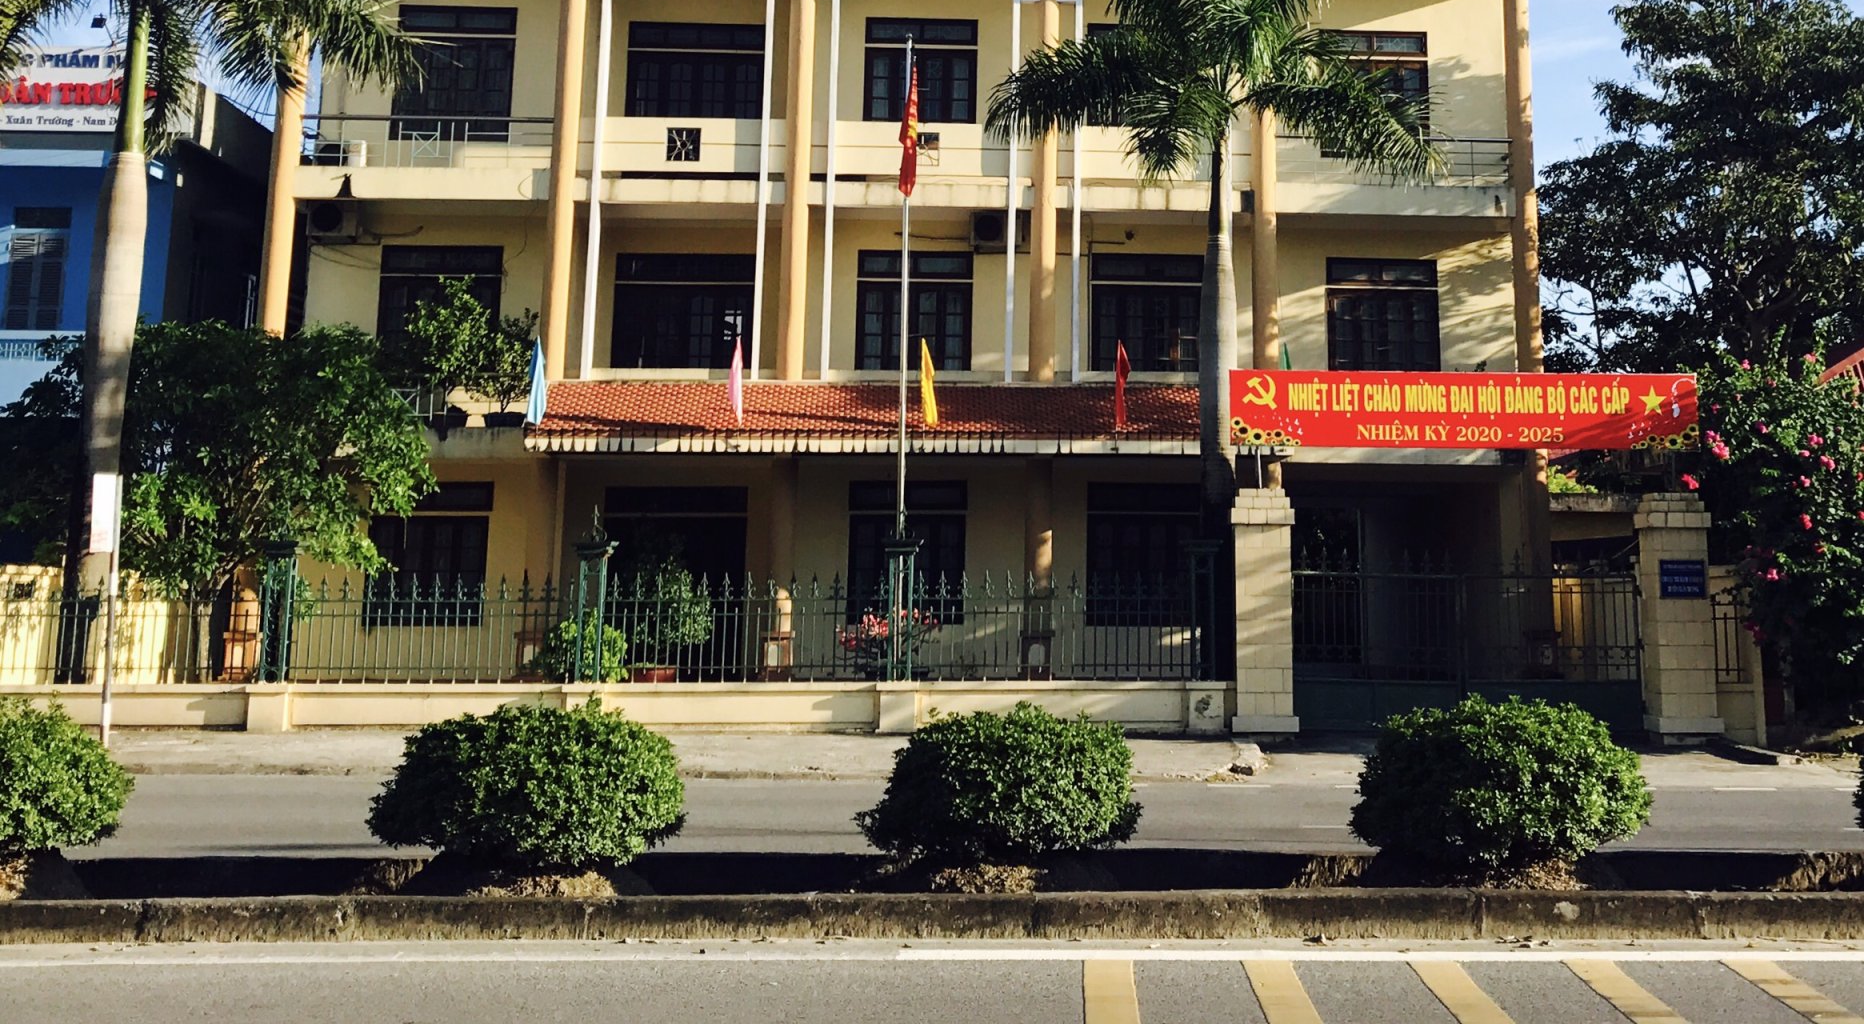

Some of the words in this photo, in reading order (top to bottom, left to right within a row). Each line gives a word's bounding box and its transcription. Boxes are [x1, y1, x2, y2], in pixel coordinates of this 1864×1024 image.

[6, 115, 33, 125] Xuân
[36, 115, 74, 127] Trường
[83, 116, 106, 125] Nam
[1288, 377, 1328, 418] NHIỆT
[1332, 378, 1360, 418] LIỆT
[1364, 379, 1401, 413] CHÀO
[1405, 379, 1447, 413] MỪNG
[1450, 385, 1474, 420] ĐẠI
[1478, 379, 1501, 420] HỘI
[1505, 377, 1544, 414] ĐẢNG
[1547, 380, 1566, 421] BỘ
[1570, 381, 1598, 414] CÁC
[1602, 377, 1630, 415] CẤP
[1357, 419, 1419, 445] NHIỆM
[1425, 420, 1450, 442] KỲ
[1456, 426, 1502, 443] 2020
[1519, 427, 1564, 443] 2025
